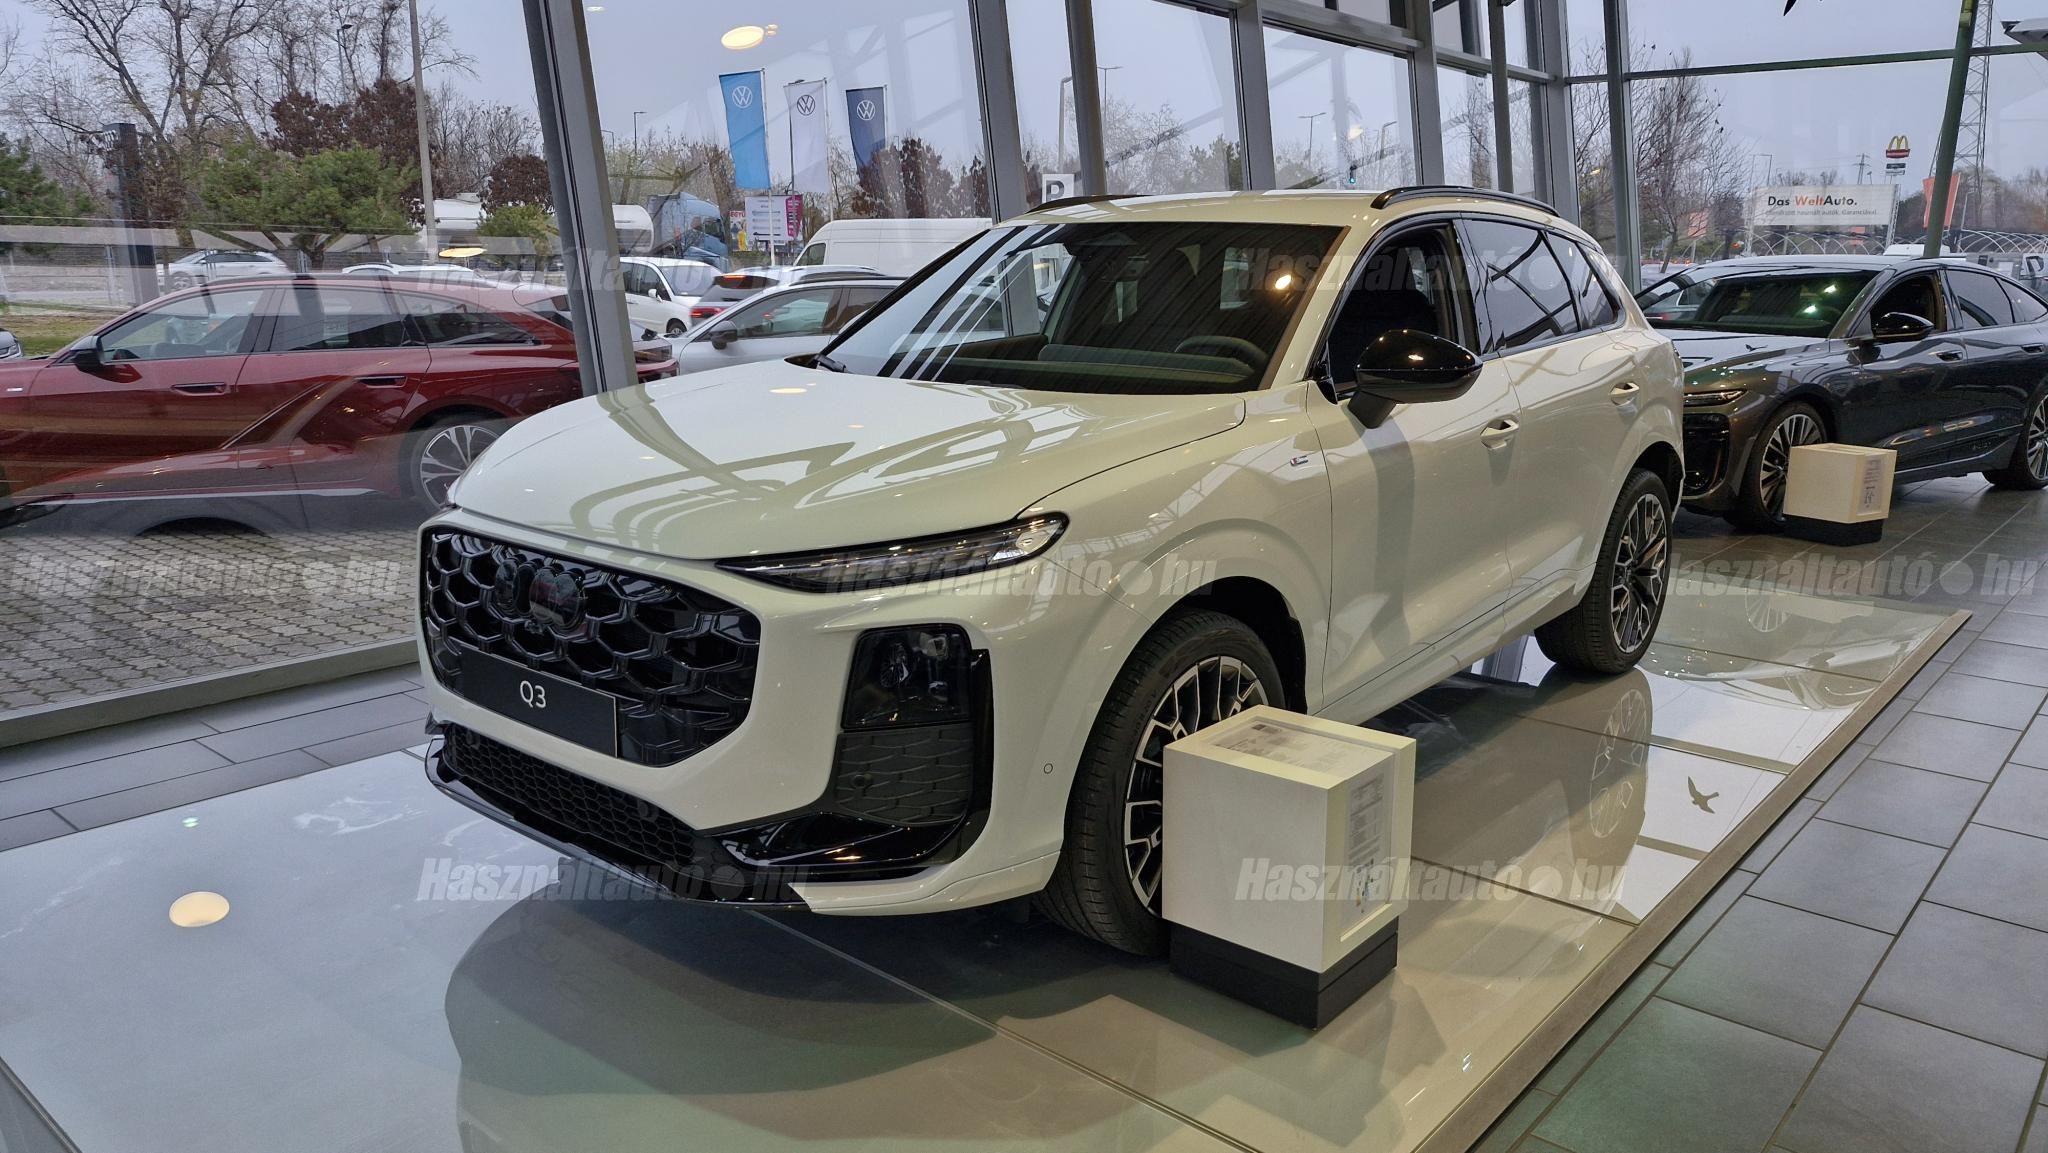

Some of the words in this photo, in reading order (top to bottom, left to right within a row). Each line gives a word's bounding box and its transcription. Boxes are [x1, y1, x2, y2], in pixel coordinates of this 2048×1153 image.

[1768, 196, 1790, 206] Das
[1795, 195, 1857, 206] WeltAuto.
[520, 680, 546, 708] Q3
